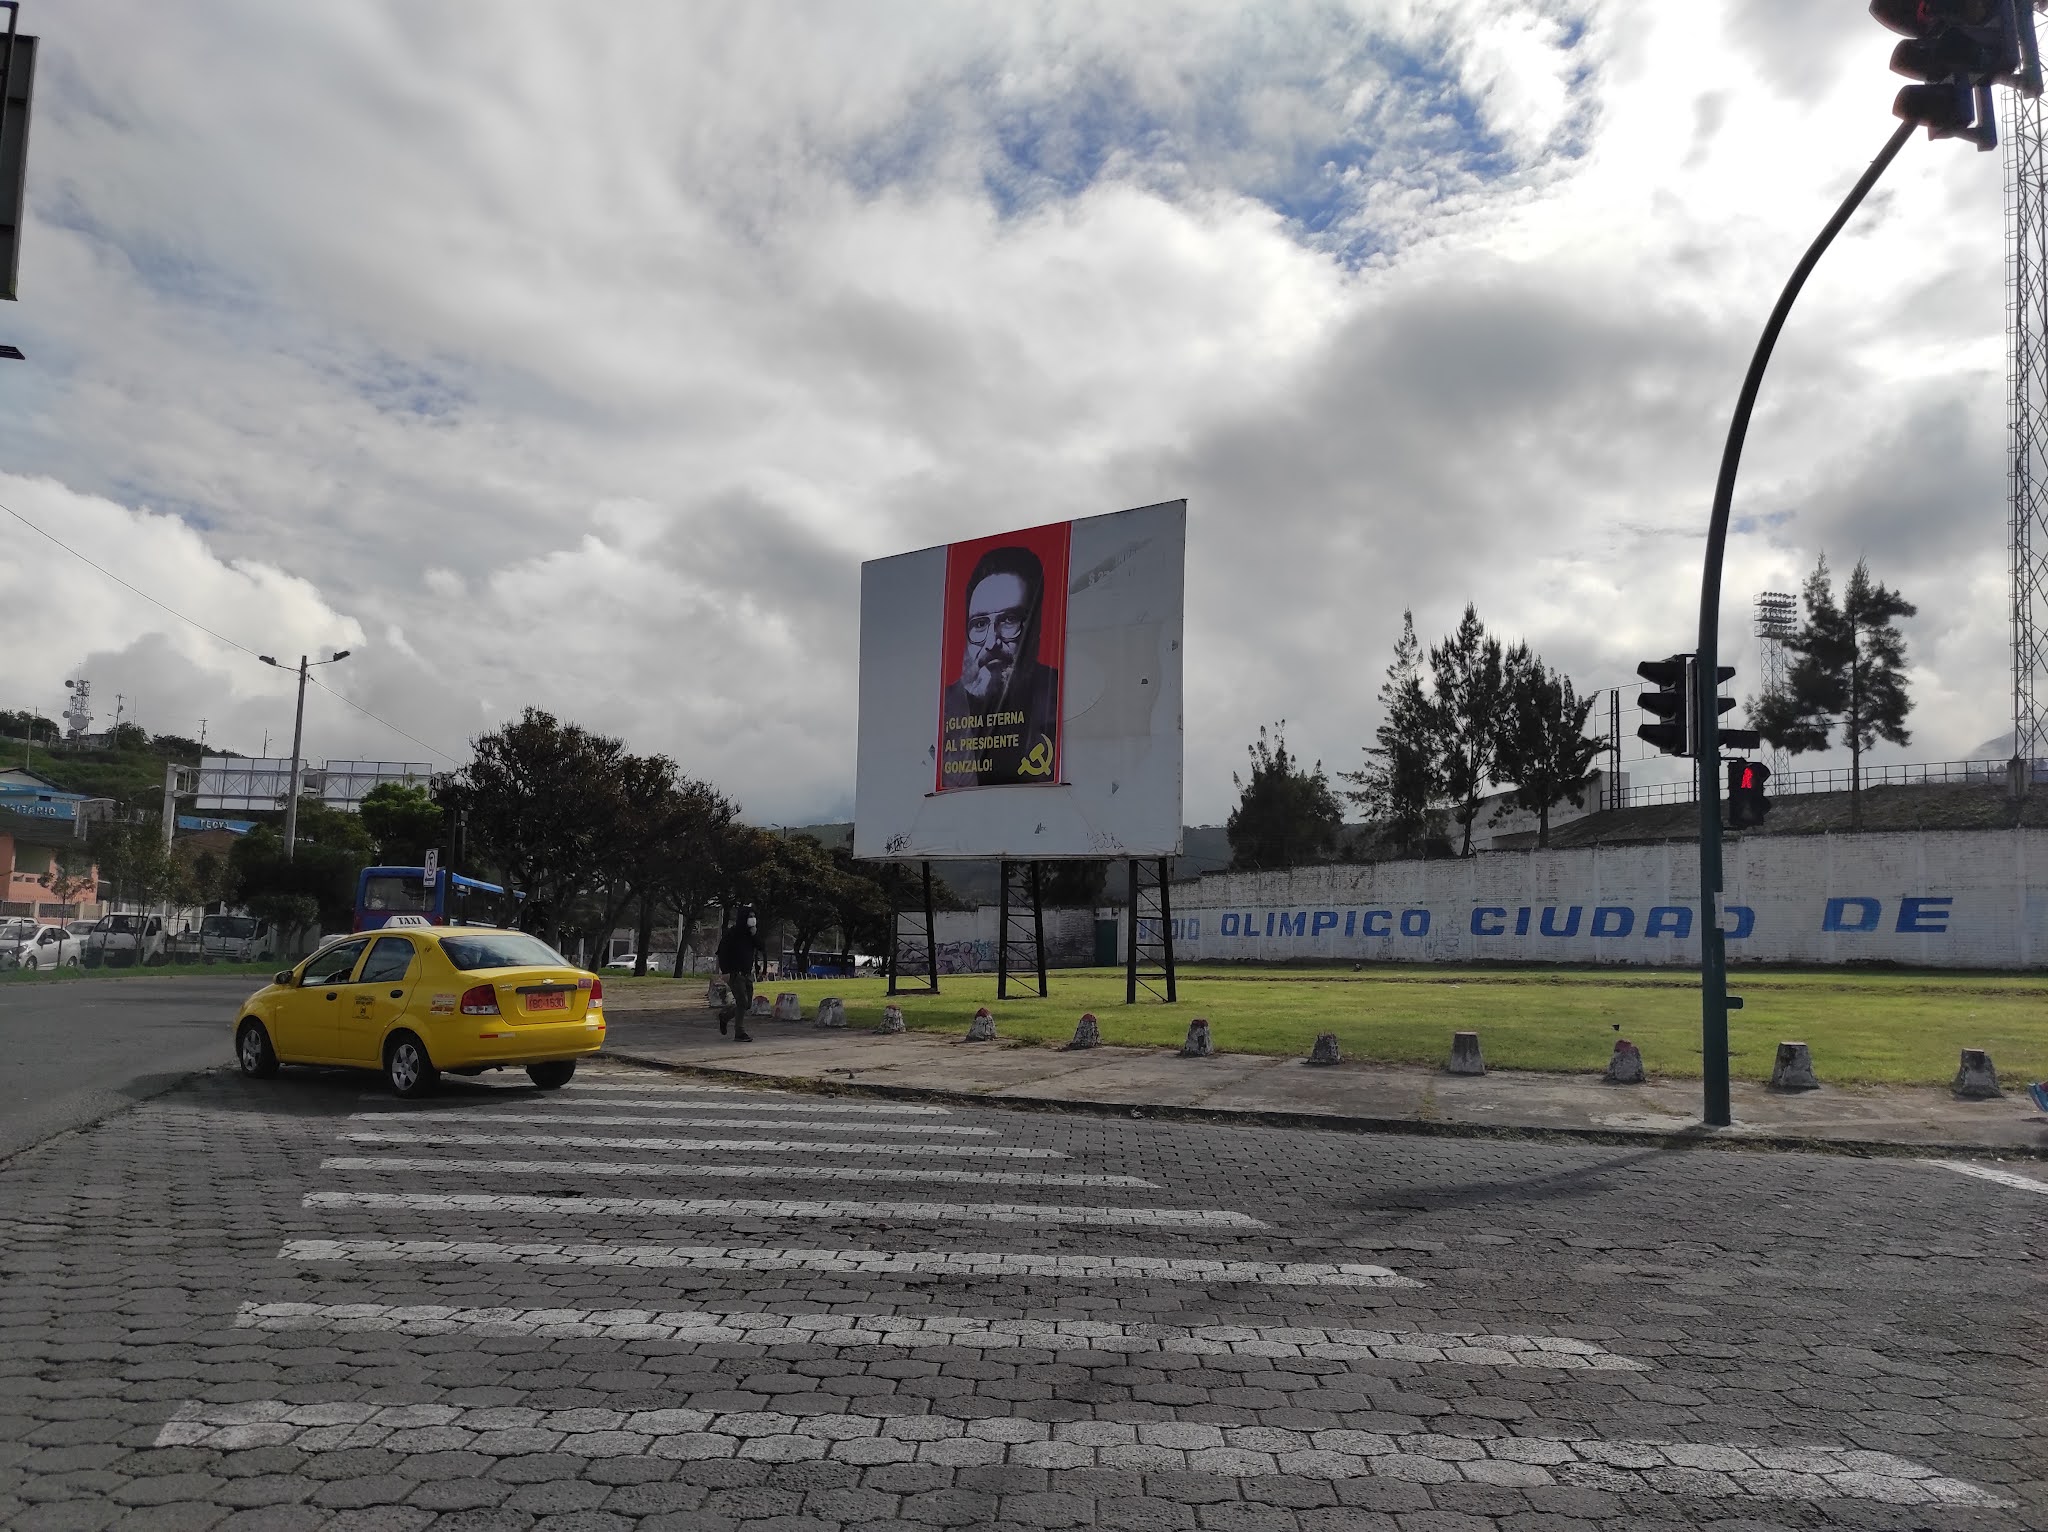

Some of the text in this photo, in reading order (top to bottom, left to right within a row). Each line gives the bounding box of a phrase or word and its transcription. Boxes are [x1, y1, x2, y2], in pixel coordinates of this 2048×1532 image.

[946, 711, 1025, 733] ¡GLORIA ETERNA
[945, 734, 1019, 752] AL PRESIDENTE
[944, 759, 993, 774] GONZALO!
[397, 917, 422, 925] TAXI
[1220, 909, 1431, 937] OLIMPICO
[1470, 906, 1756, 939] CIUDAD
[1822, 897, 1954, 933] DE
